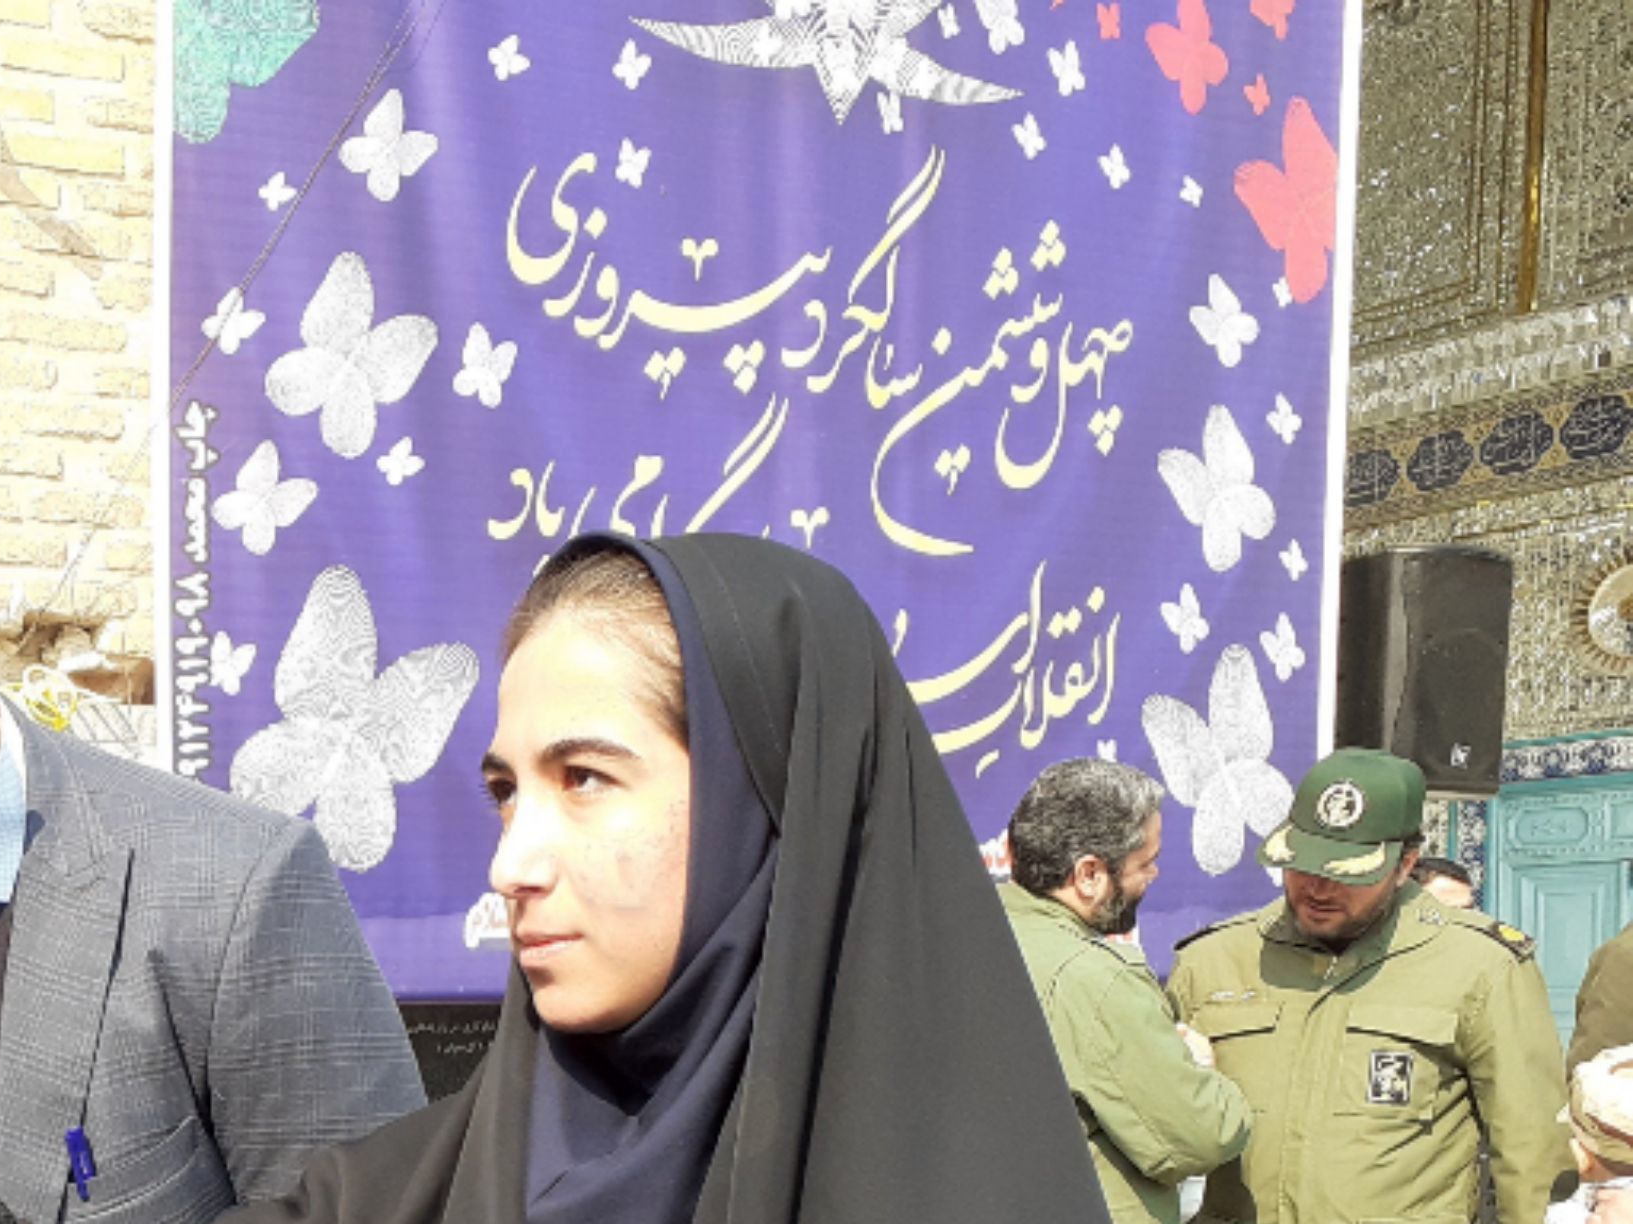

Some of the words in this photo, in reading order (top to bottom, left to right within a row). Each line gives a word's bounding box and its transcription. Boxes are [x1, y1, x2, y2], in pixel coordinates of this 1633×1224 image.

[506, 151, 833, 399] پیروزی
[780, 144, 945, 409] سالگرد
[1011, 338, 1050, 403] و
[175, 400, 219, 470] چاپ
[871, 220, 1067, 556] ششمین
[995, 320, 1133, 489] چهل
[175, 572, 210, 777] ۹۱۲۴۹۱۹۰۹۸
